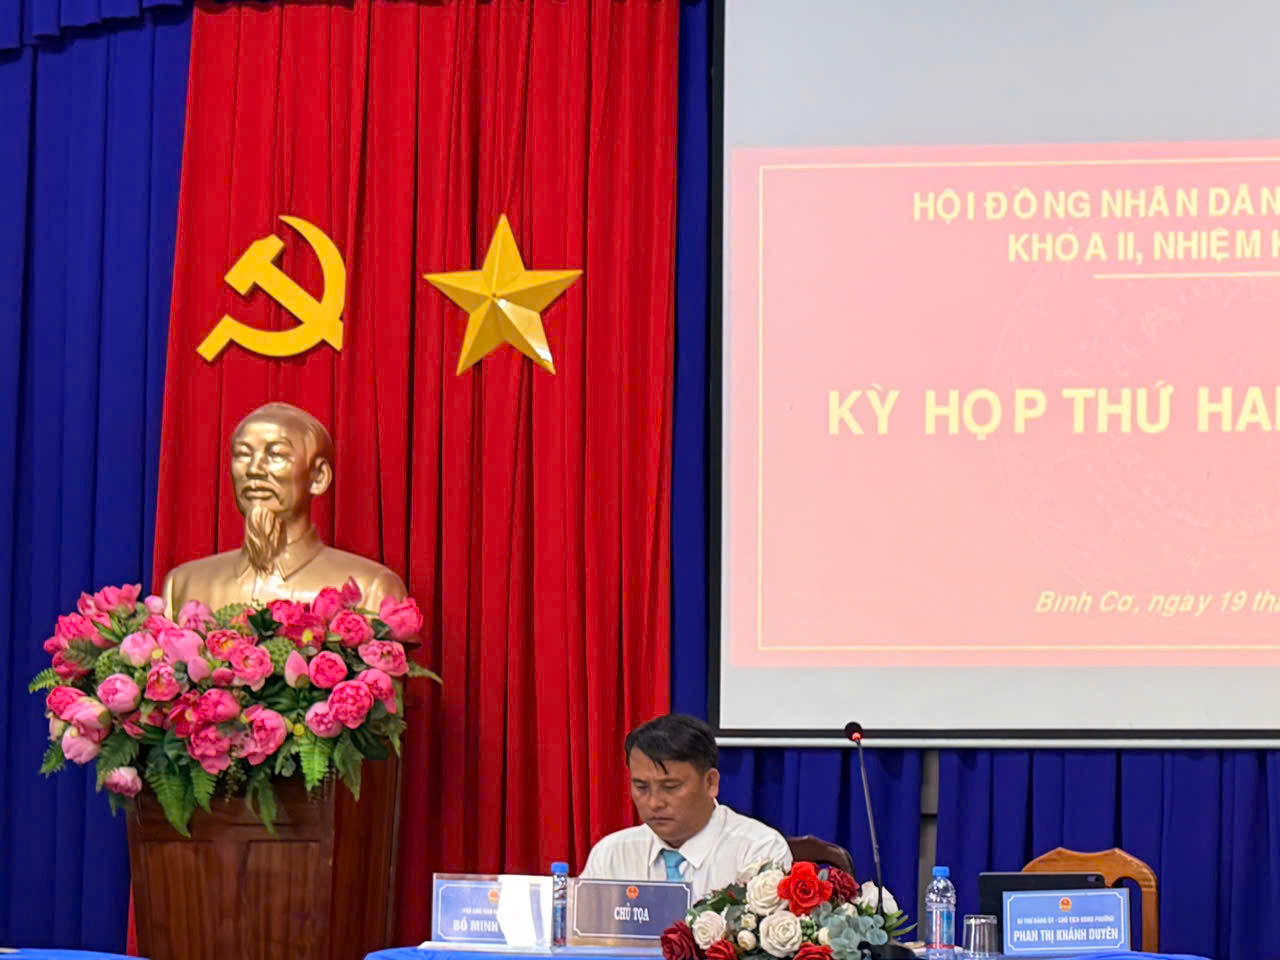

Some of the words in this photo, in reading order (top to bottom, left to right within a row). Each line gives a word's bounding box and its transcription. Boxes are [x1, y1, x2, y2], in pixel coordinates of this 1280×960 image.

[913, 187, 976, 225] HỘI
[1101, 185, 1199, 219] NHÂN
[1117, 231, 1144, 266] II,
[1153, 227, 1262, 262] NHIỆM
[828, 383, 901, 436] KỲ
[925, 388, 1047, 441] HỌP
[1062, 380, 1175, 434] THỨ
[1220, 590, 1249, 613] 19
[1013, 929, 1039, 943] PHAN
[1040, 929, 1055, 944] THỊ
[1056, 926, 1087, 942] KHÁNH
[1089, 926, 1119, 940] DUYÊN
